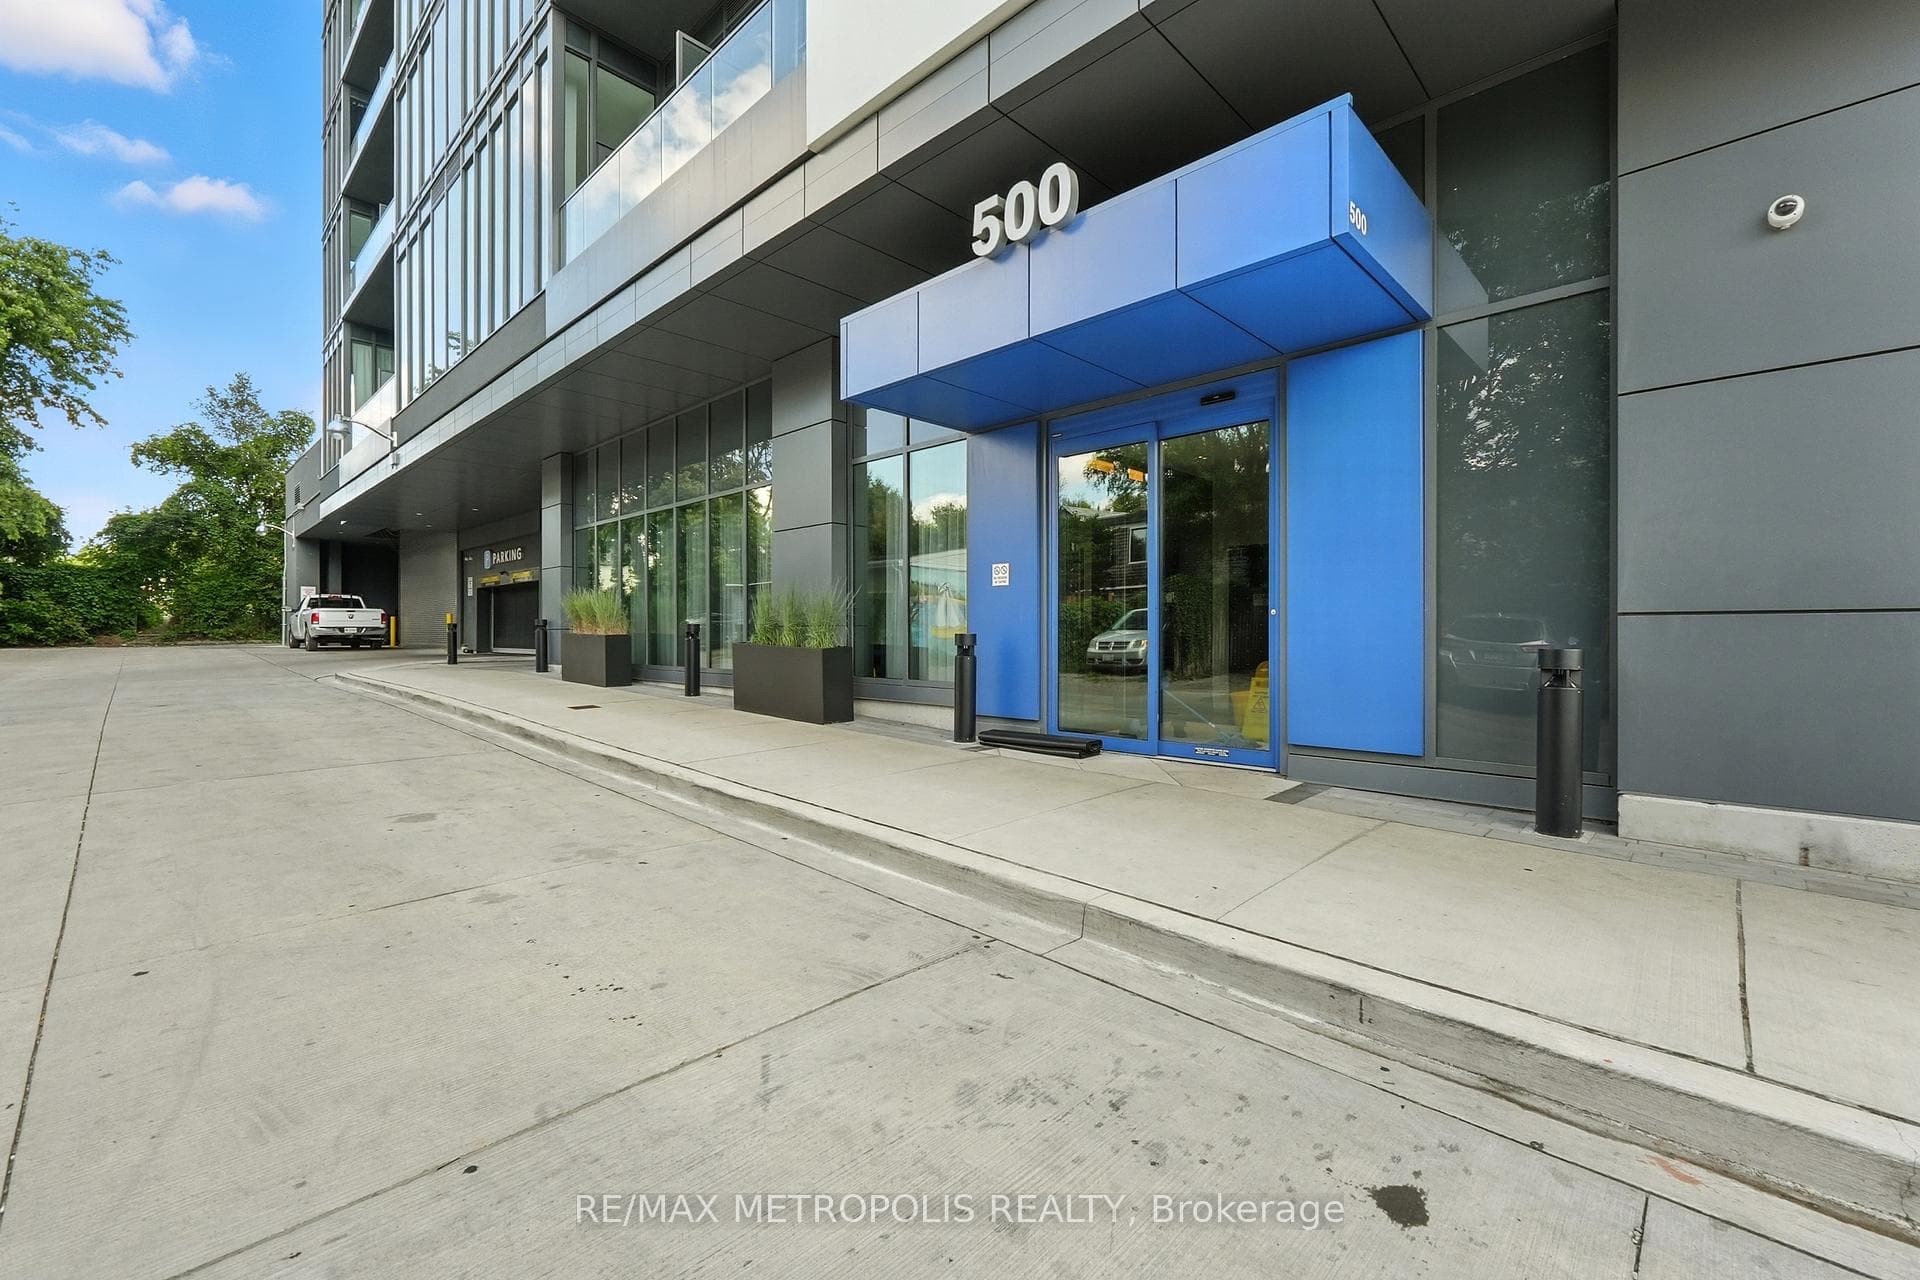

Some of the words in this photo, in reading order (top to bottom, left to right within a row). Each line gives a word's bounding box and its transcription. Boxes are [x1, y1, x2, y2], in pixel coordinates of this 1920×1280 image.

[971, 161, 1079, 259] 500
[1349, 200, 1367, 236] 500
[492, 547, 522, 565] PARKING
